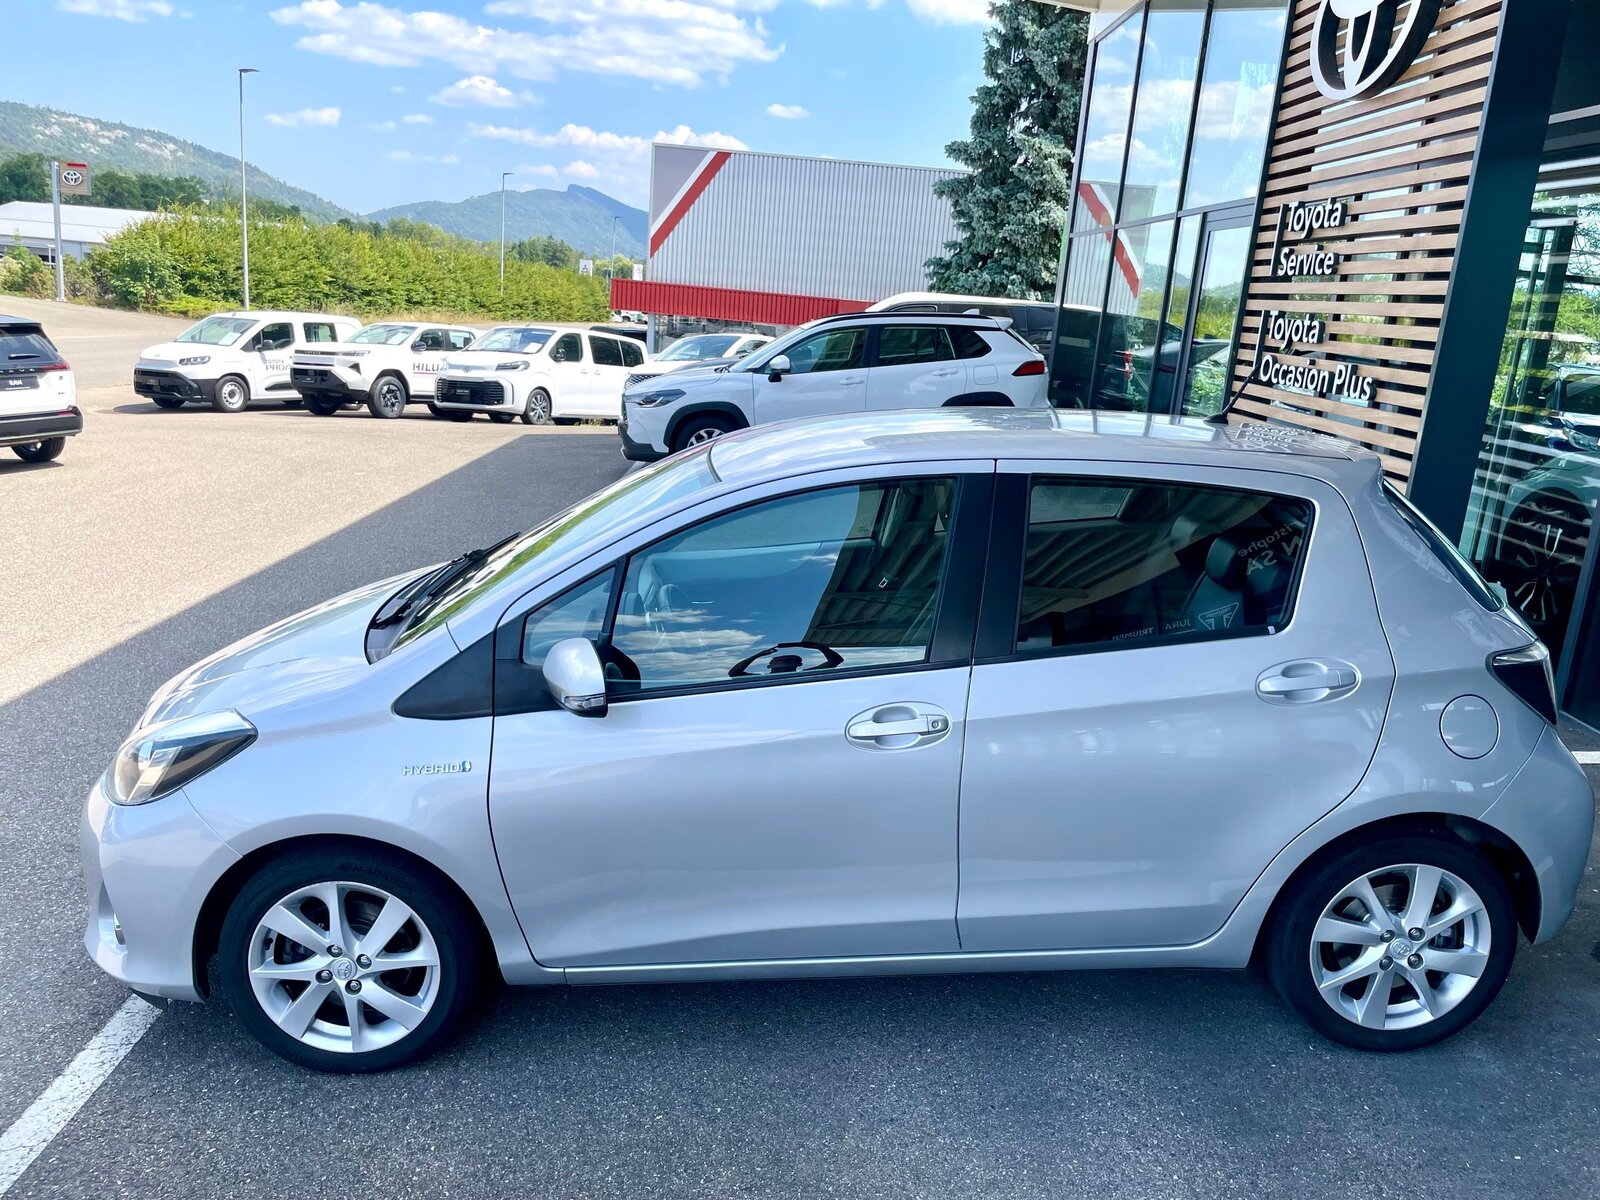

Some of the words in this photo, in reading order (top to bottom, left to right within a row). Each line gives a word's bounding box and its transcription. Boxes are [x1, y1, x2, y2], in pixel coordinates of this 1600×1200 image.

[1287, 198, 1342, 239] Toyota
[1278, 246, 1335, 276] Service
[1268, 310, 1320, 350] Toyota
[1260, 354, 1329, 393] Occasion
[1332, 364, 1373, 400] Plus
[402, 763, 461, 776] HYBRID
